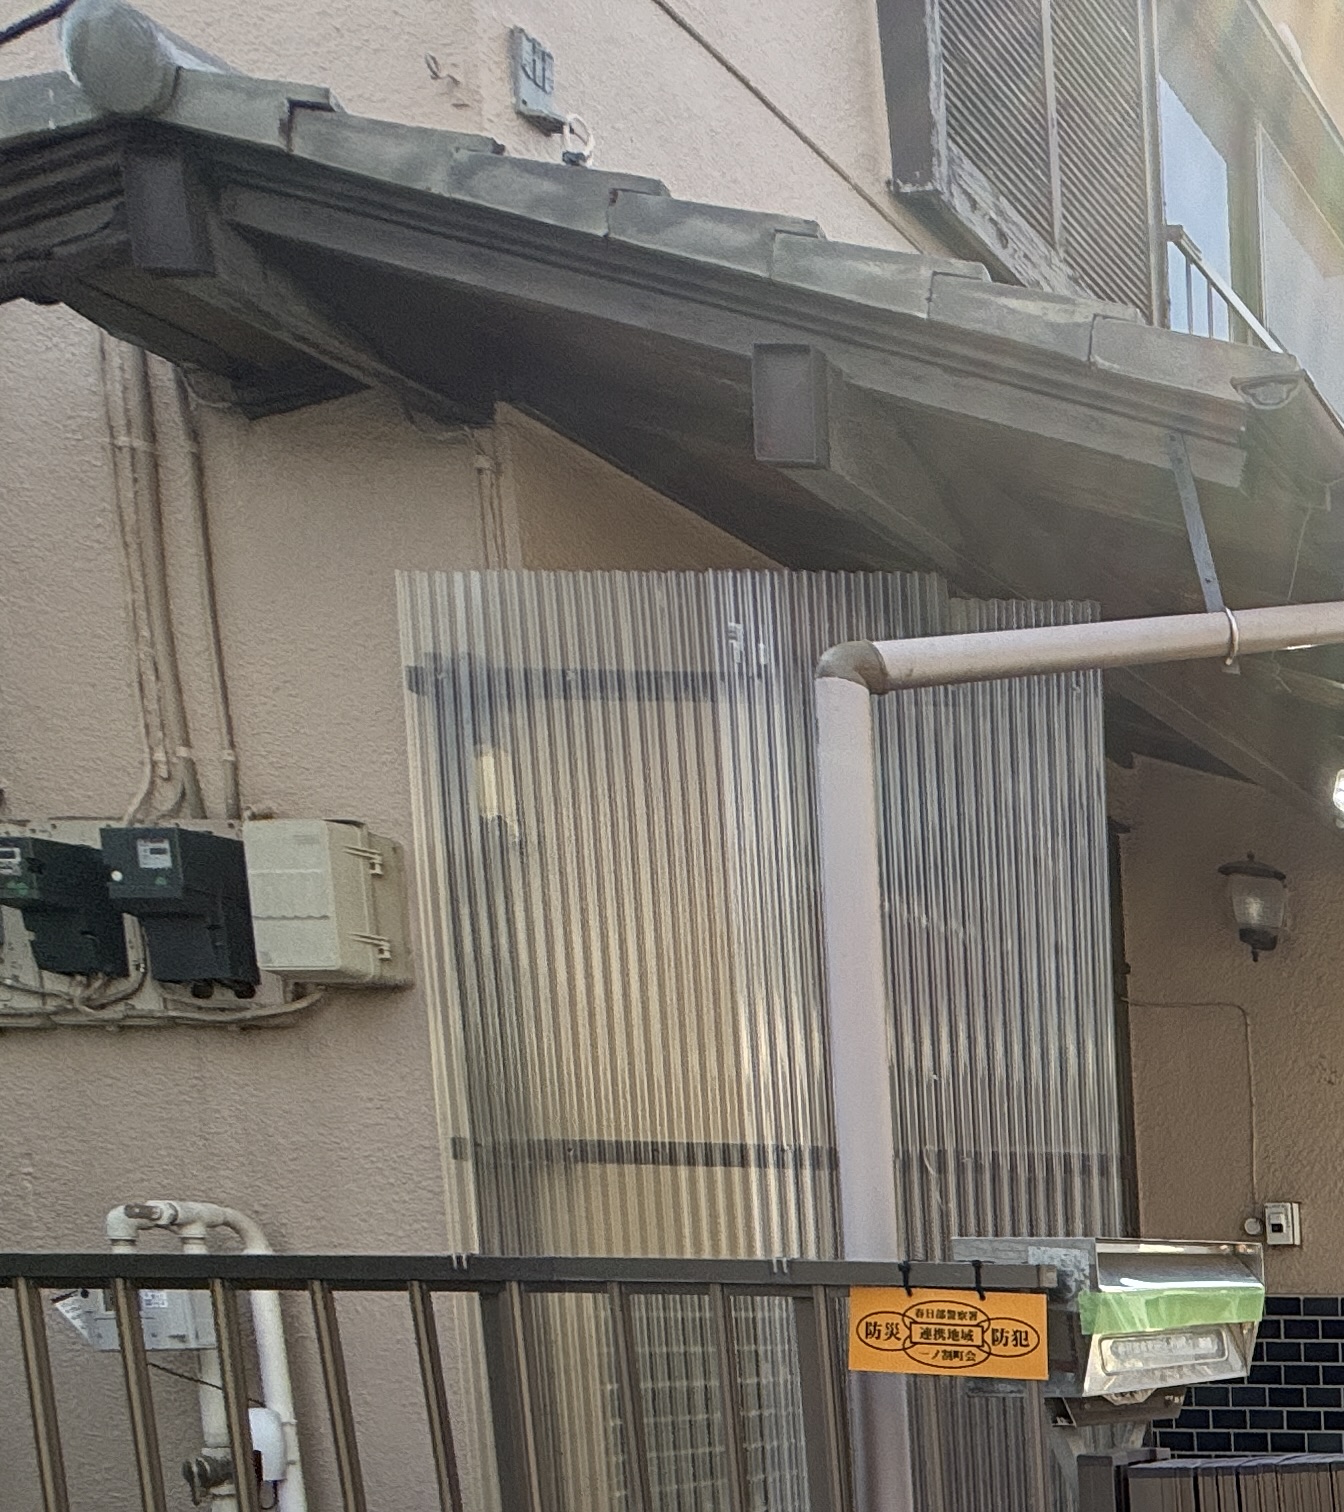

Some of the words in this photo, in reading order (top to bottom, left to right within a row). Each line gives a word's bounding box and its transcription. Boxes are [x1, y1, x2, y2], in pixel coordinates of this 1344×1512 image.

[915, 1308, 978, 1321] 春日部警察署
[864, 1321, 902, 1341] 防災
[919, 1326, 974, 1342] 連携地域
[991, 1328, 1030, 1347] 防犯
[919, 1349, 976, 1362] 一ノ割町会
